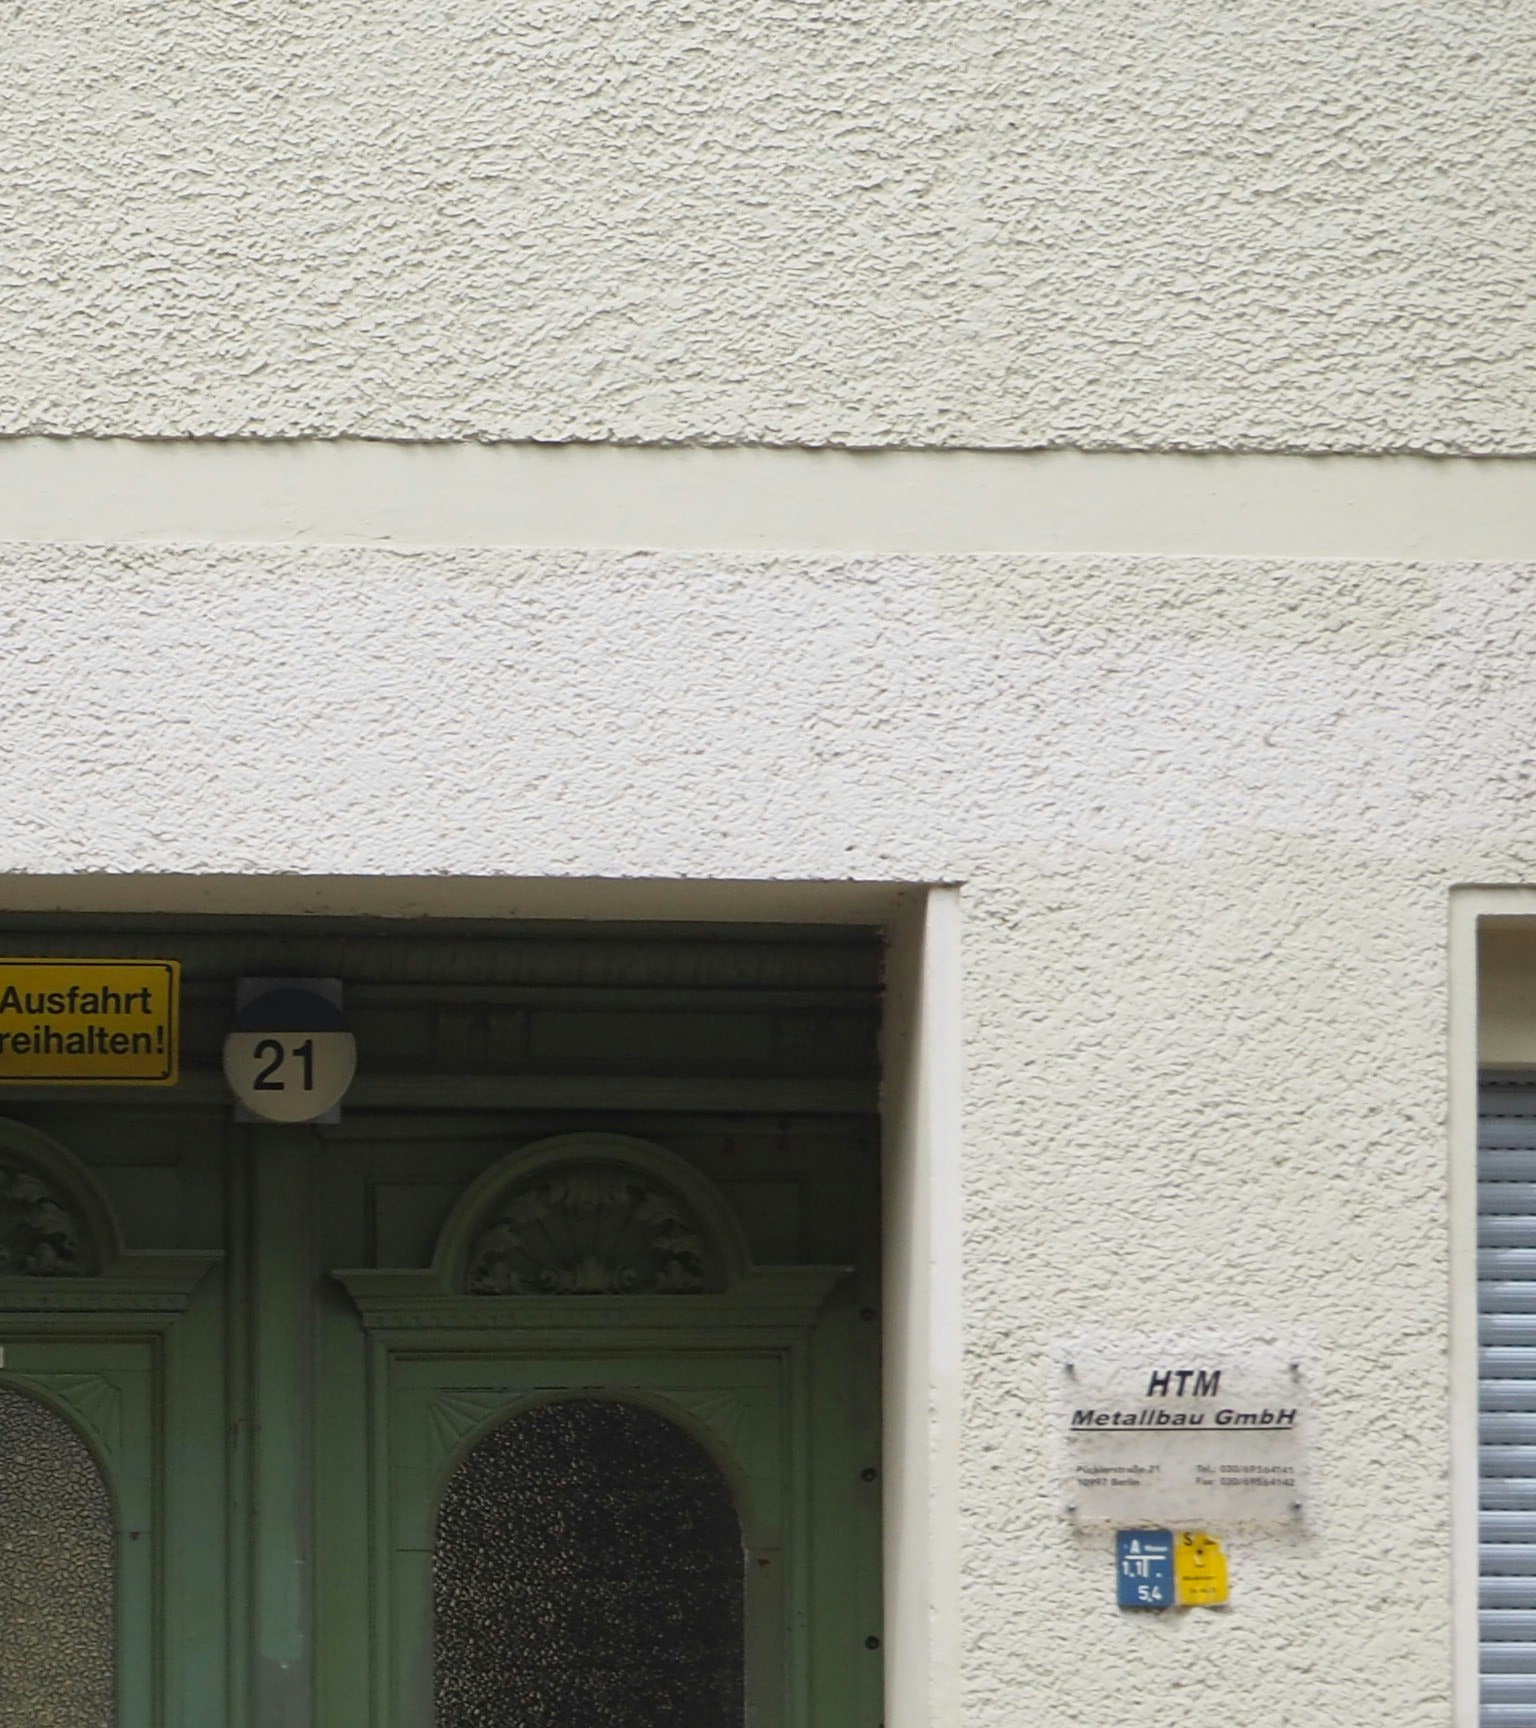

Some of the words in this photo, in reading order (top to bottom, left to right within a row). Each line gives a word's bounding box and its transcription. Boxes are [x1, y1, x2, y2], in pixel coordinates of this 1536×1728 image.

[252, 1038, 316, 1091] 21
[1146, 1369, 1222, 1397] HTM
[1070, 1409, 1205, 1426] Metallbau
[1215, 1408, 1298, 1426] GmbH
